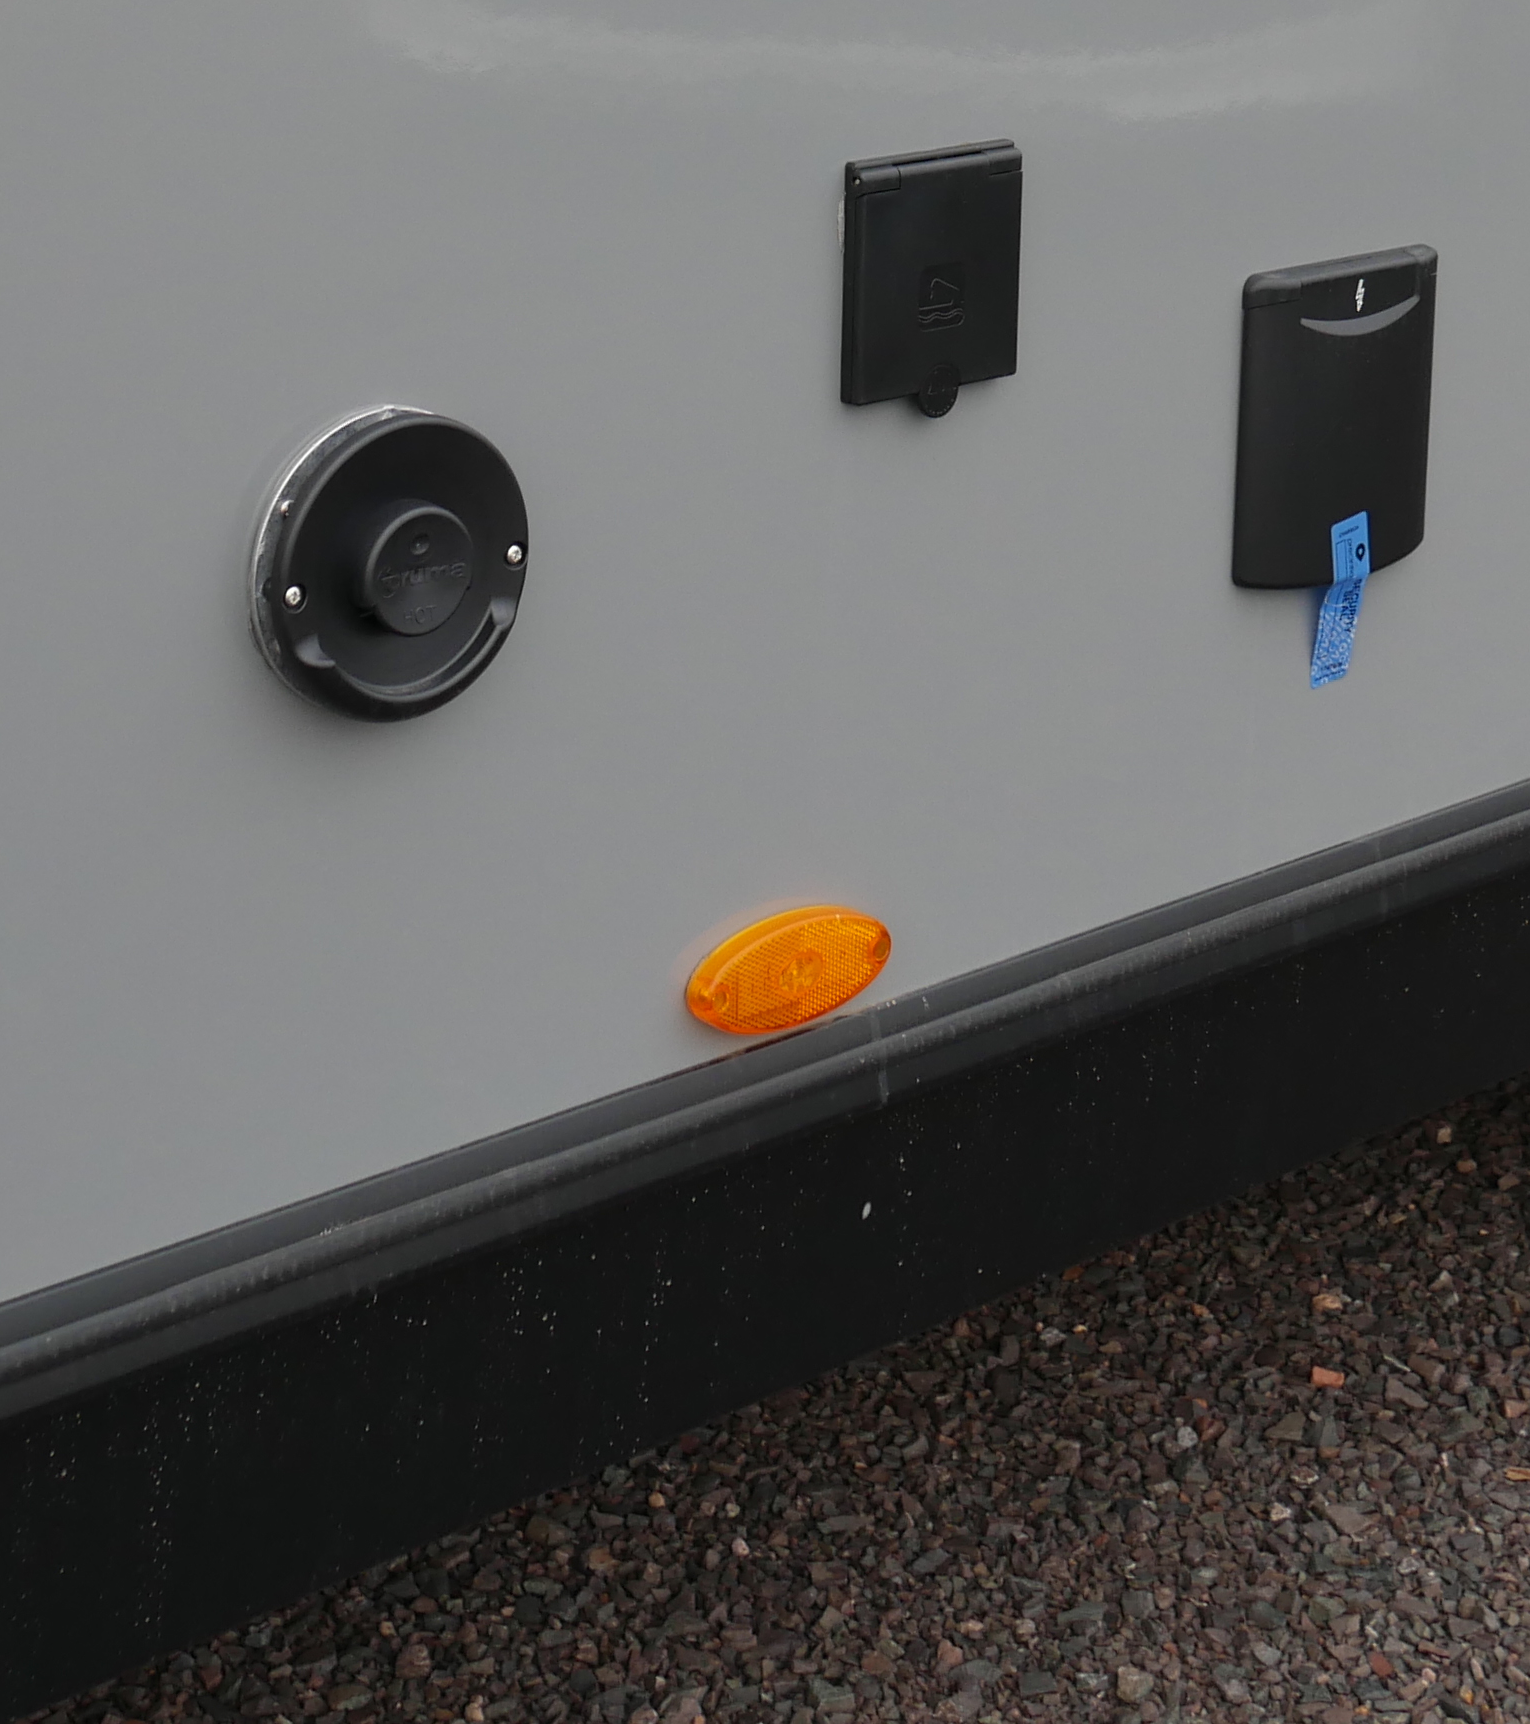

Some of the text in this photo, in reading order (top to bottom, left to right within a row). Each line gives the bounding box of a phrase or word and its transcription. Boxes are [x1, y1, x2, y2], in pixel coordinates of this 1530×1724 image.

[377, 562, 466, 599] truma
[403, 605, 438, 625] HOT
[1344, 578, 1364, 634] SECURITY
